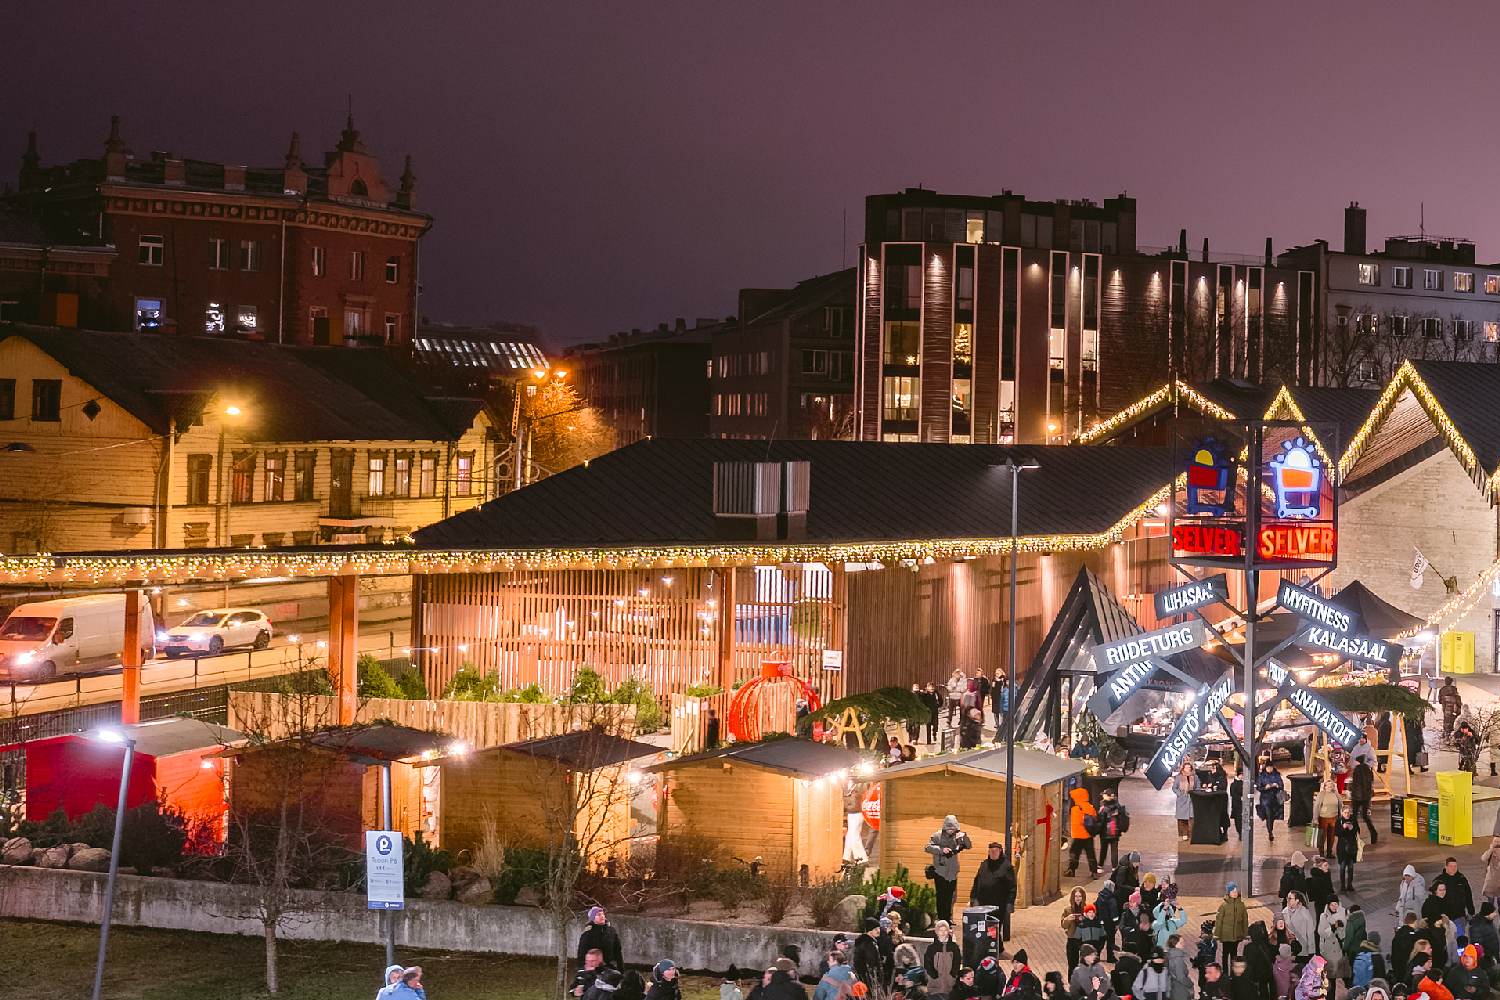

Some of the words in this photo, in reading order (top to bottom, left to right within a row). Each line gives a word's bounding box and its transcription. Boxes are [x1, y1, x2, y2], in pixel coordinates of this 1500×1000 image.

[1173, 525, 1240, 555] SELVER
[1260, 526, 1335, 559] SELVER
[1283, 586, 1350, 632] MYFITNESS
[1106, 627, 1194, 665] RIIDETURG
[1308, 627, 1388, 663] KALASAAL
[1289, 678, 1356, 745] NAVATOIT
